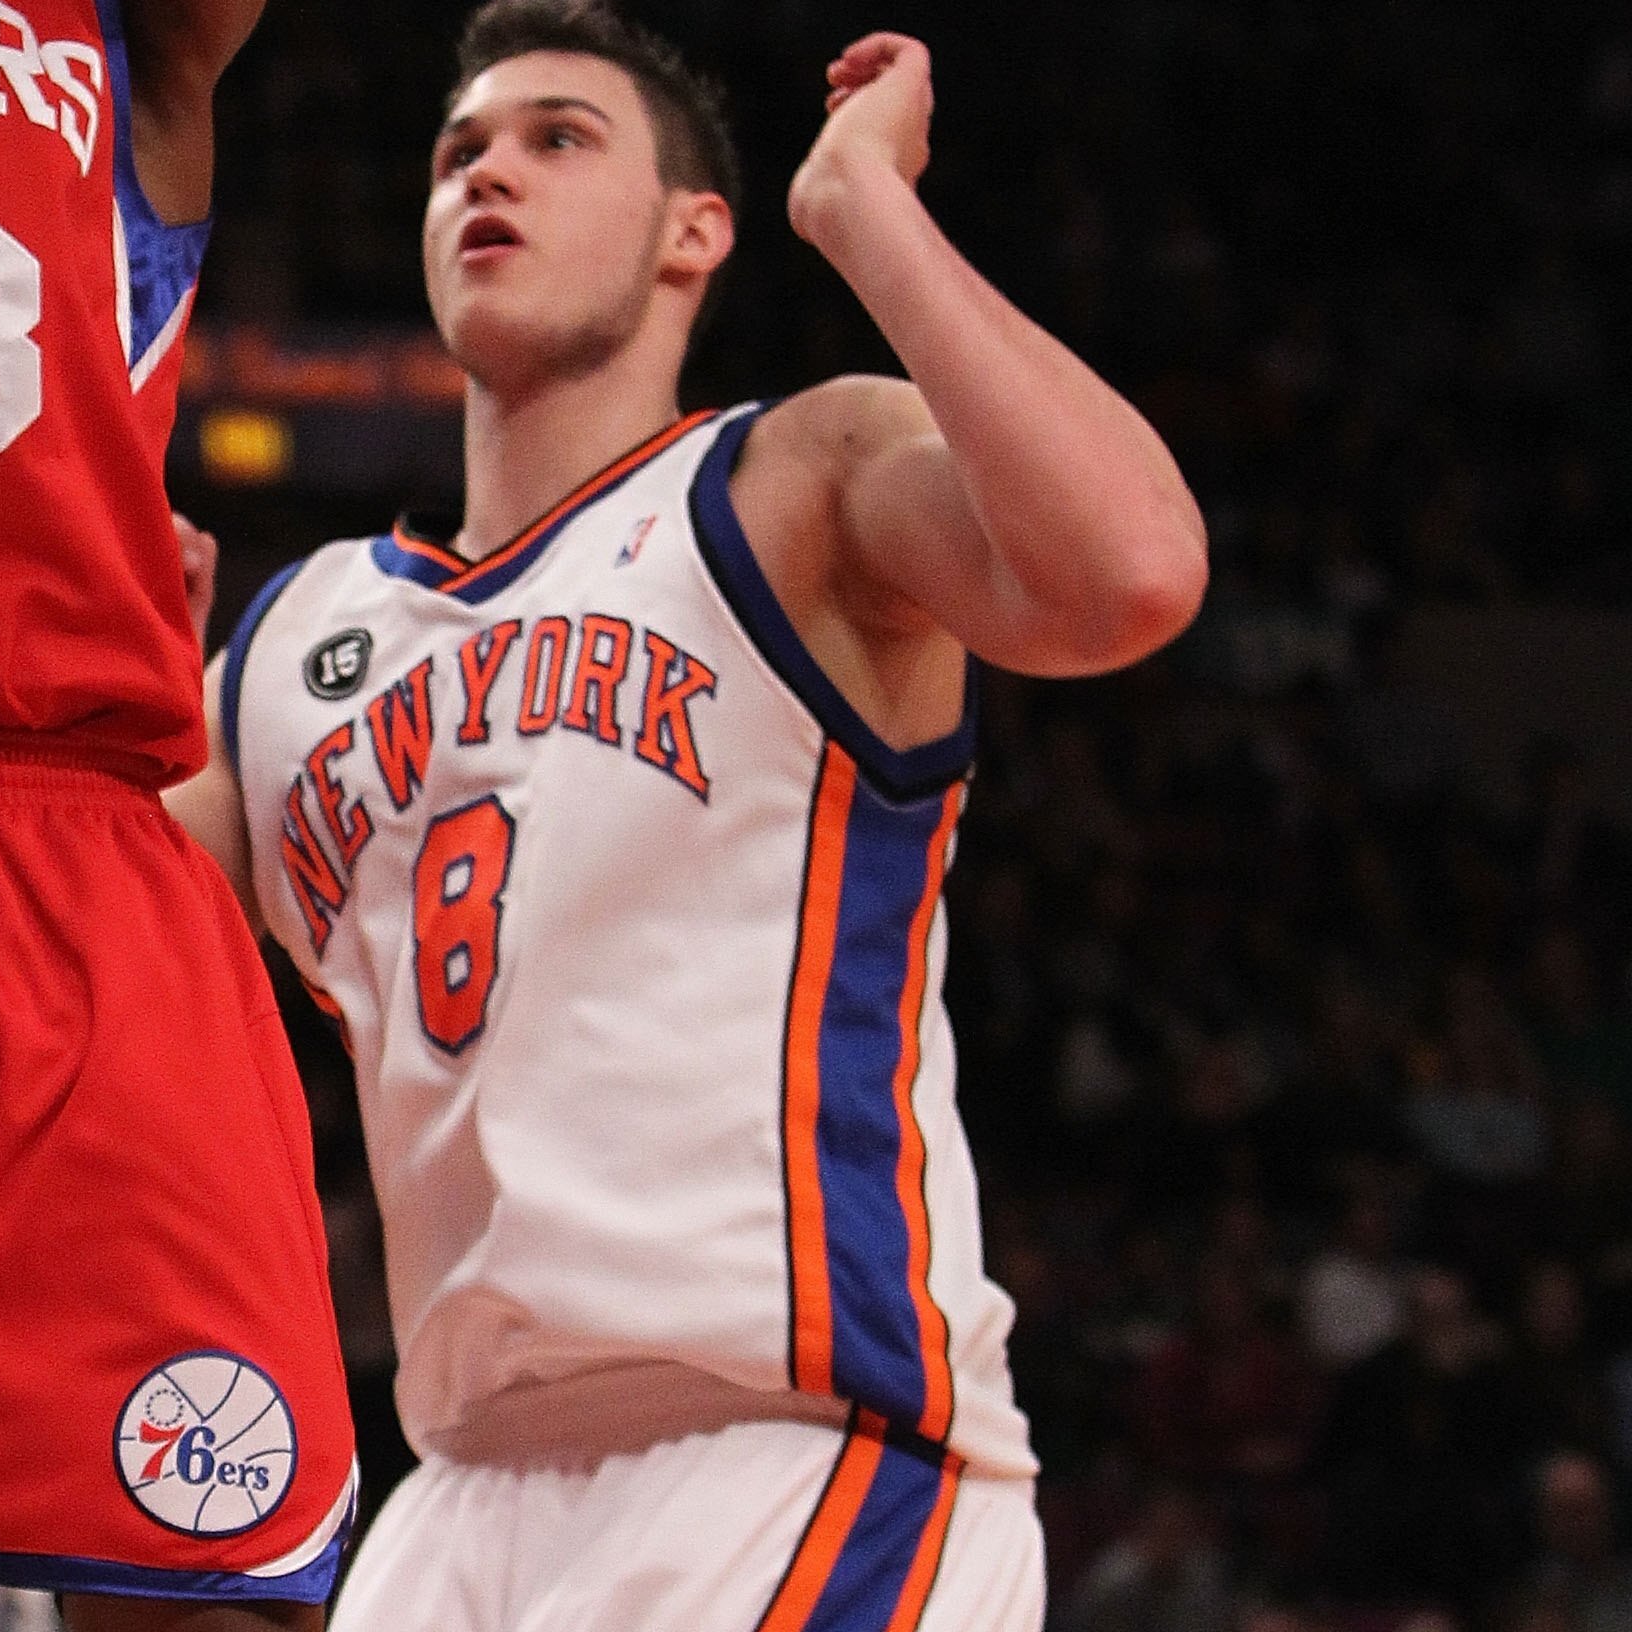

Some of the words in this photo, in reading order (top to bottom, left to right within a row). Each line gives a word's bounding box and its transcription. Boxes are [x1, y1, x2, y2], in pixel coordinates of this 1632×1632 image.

[321, 639, 361, 685] 15
[281, 656, 434, 961] NEW
[457, 613, 718, 806] YORK
[413, 793, 516, 1056] 8
[139, 1419, 270, 1490] 76ers
